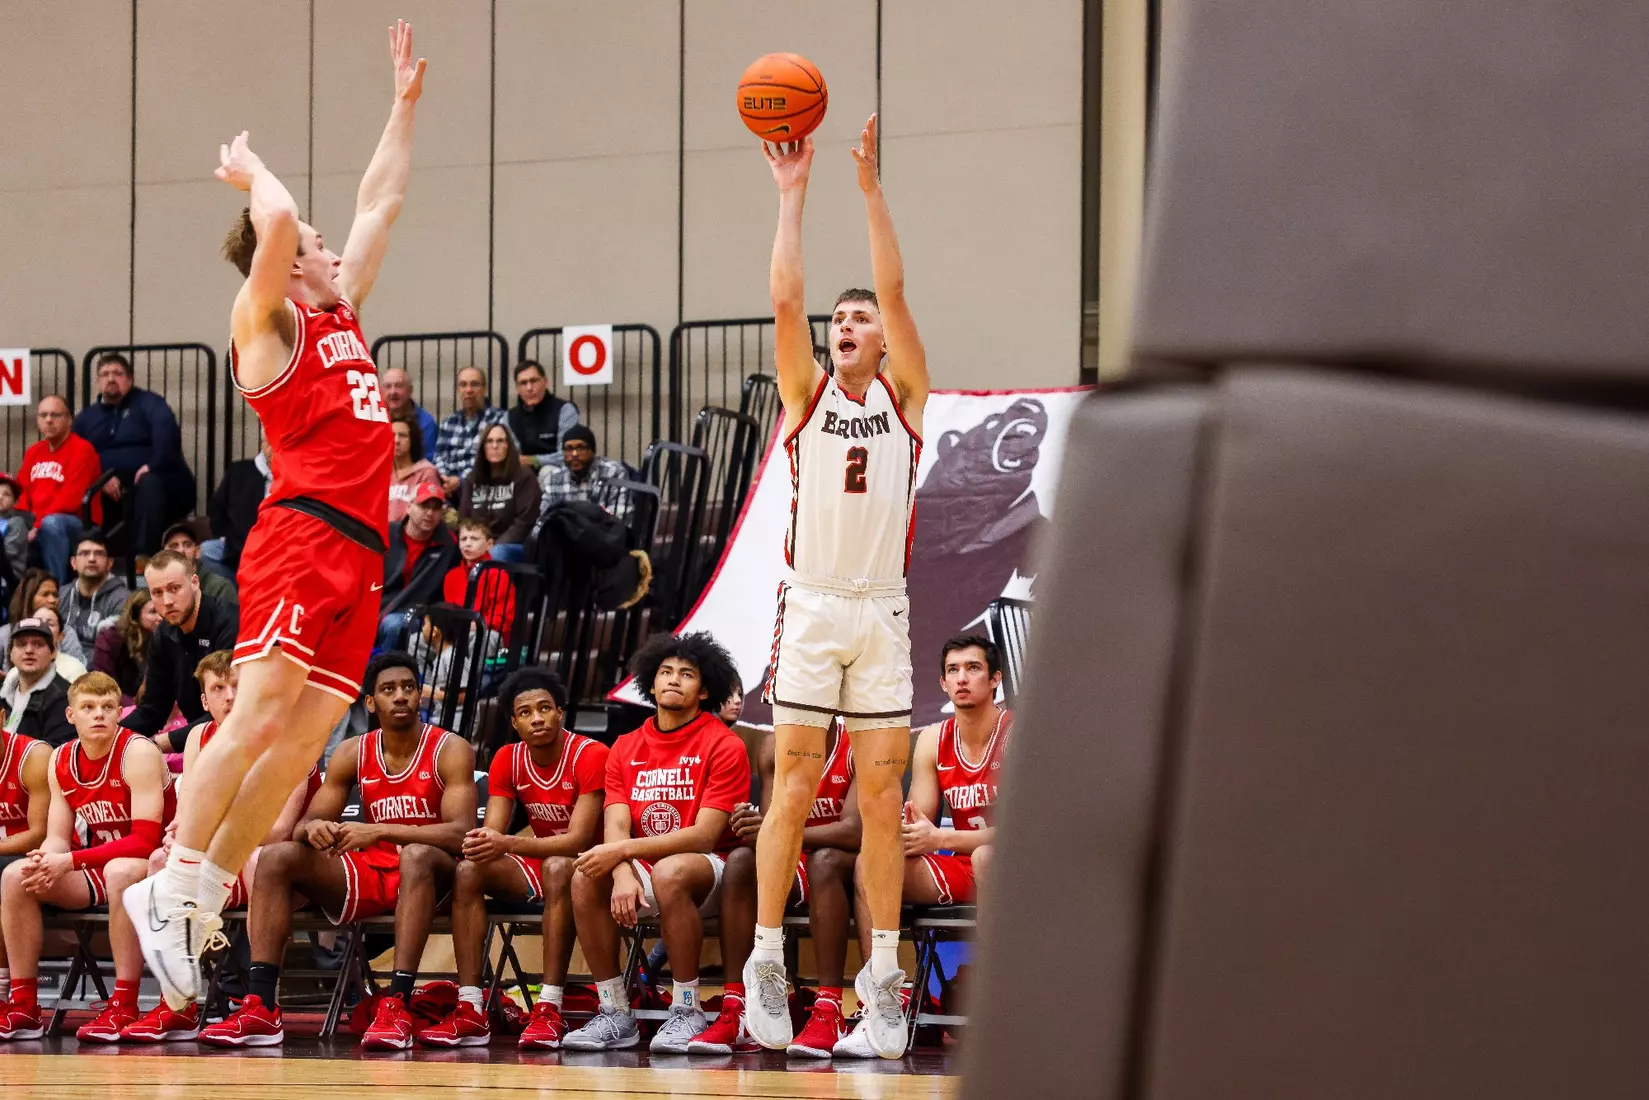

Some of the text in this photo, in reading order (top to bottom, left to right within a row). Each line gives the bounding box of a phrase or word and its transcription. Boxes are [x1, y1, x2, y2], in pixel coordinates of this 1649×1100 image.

[744, 97, 786, 110] ELITE
[316, 329, 376, 369] CORN
[569, 334, 606, 376] O
[0, 358, 23, 395] N
[346, 369, 390, 424] 22
[820, 410, 890, 439] BROWN
[844, 445, 868, 494] 2
[289, 603, 305, 636] C
[631, 786, 696, 801] BASKETBALL
[636, 768, 694, 787] CORNELL
[369, 795, 437, 823] CORNELL
